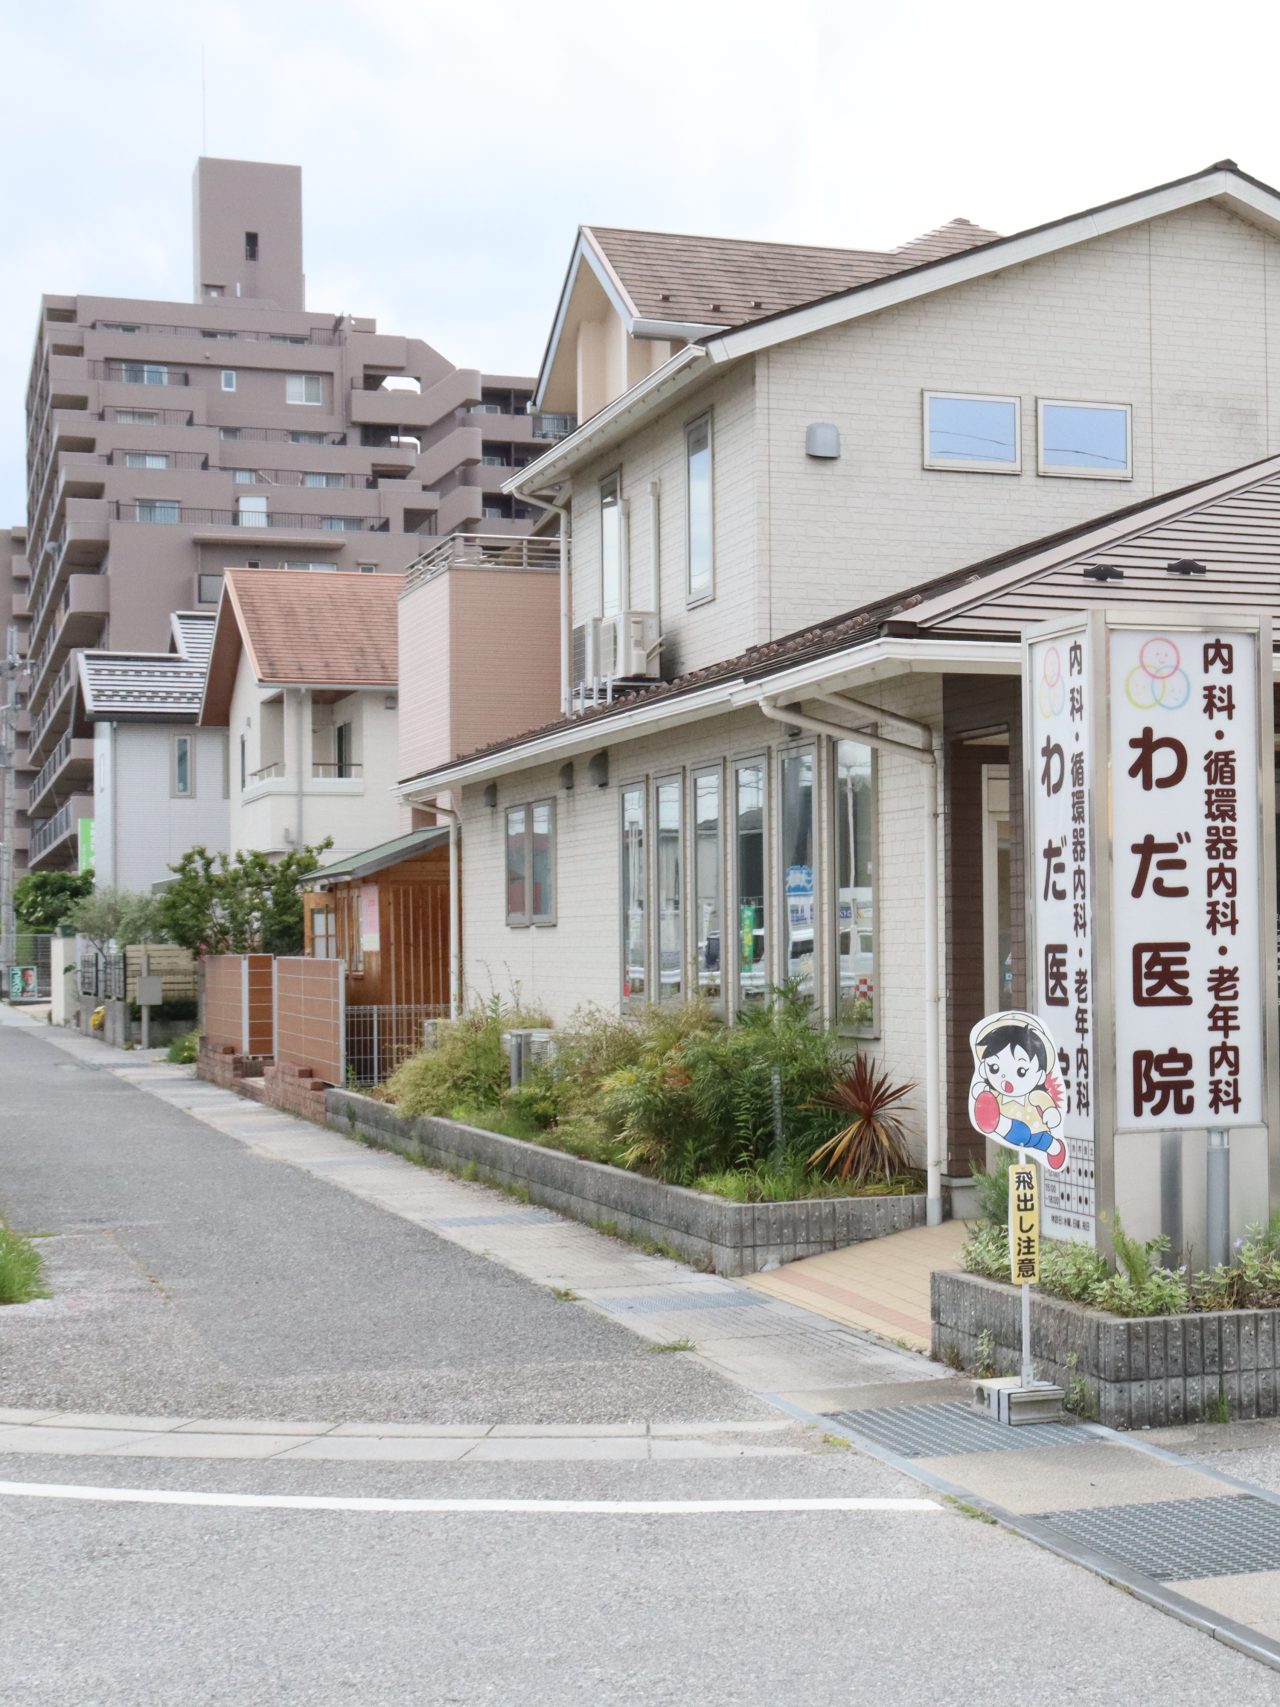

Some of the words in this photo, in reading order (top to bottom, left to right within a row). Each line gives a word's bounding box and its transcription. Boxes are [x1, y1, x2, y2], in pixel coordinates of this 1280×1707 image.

[1128, 726, 1195, 1117] わだ医院
[1203, 638, 1241, 1115] 内科・循環器内科・老年内科
[1015, 1170, 1036, 1278] 飛出し注意
